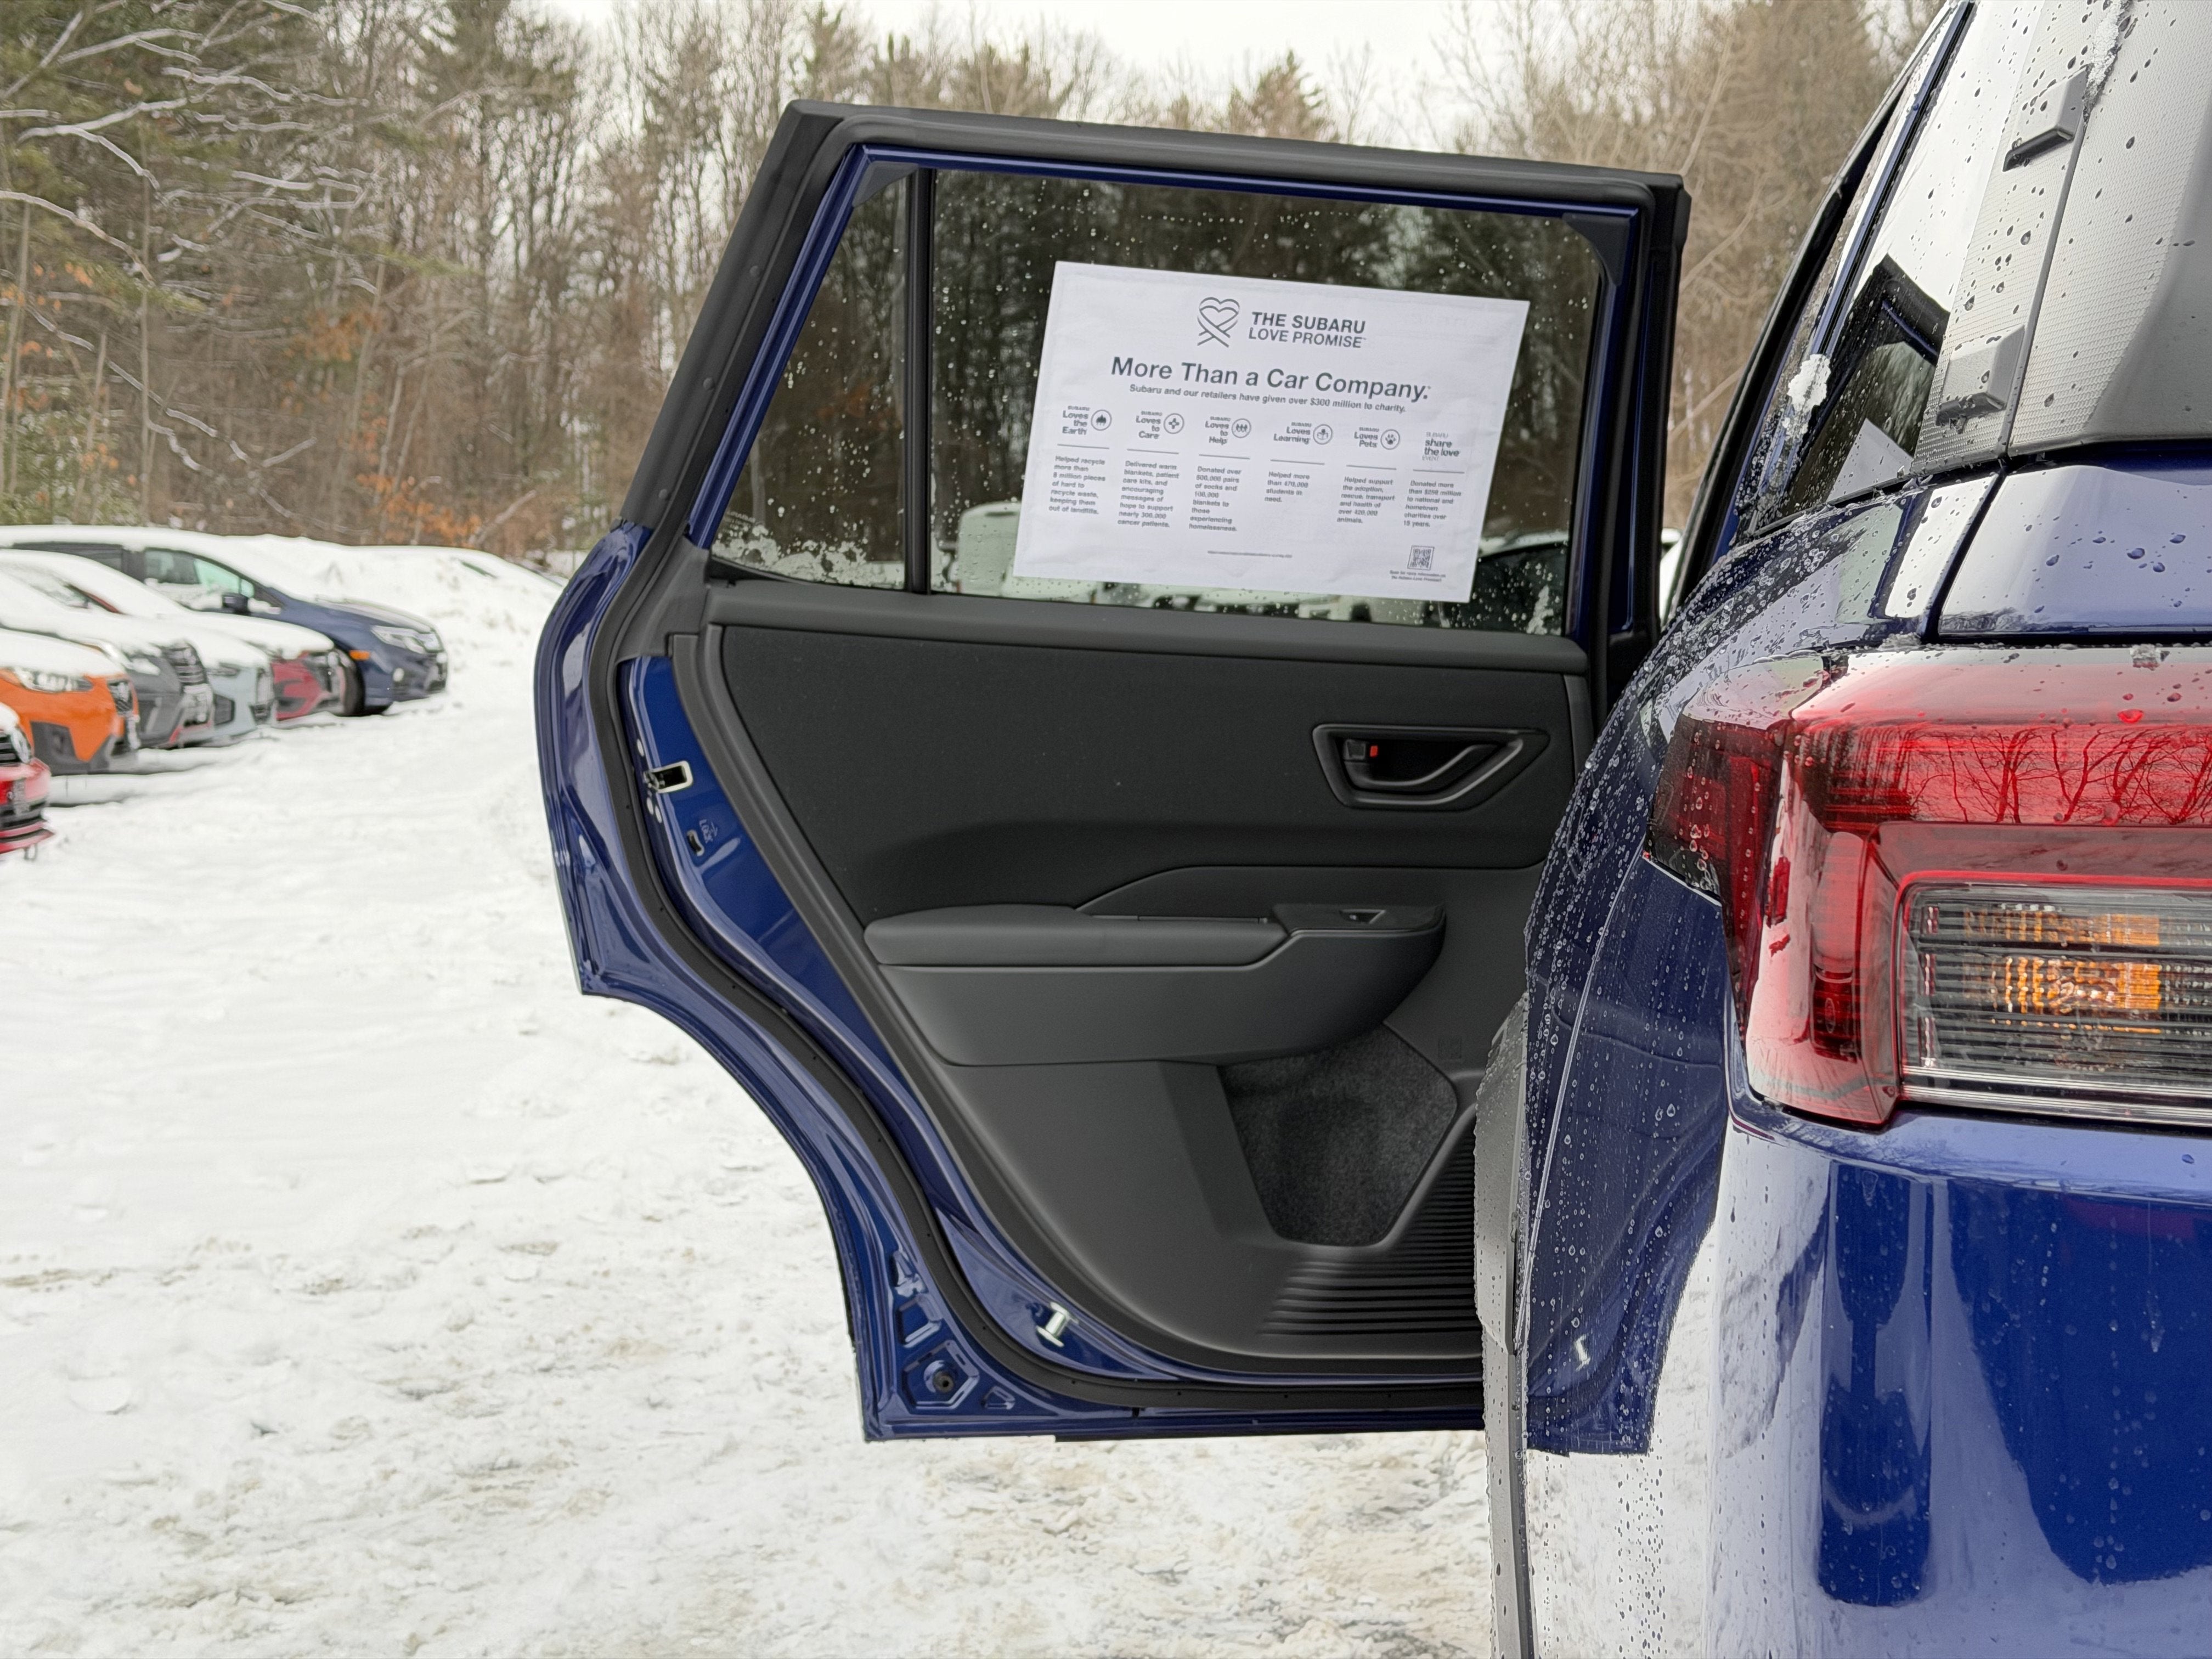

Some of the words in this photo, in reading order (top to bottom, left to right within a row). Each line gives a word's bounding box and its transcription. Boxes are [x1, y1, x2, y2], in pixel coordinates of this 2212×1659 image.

[1252, 312, 1286, 327] THE
[1291, 315, 1365, 334] SUBARU
[1248, 328, 1289, 342] LOVE
[1292, 331, 1362, 348] PROMISE
[1111, 357, 1172, 379] More
[1181, 362, 1238, 385] Than
[1245, 371, 1259, 386] a
[1267, 368, 1309, 389] Car
[1130, 384, 1162, 394] Subaru
[1201, 391, 1237, 400] retailers
[1239, 393, 1260, 402] have
[1262, 395, 1285, 404] given
[1310, 398, 1330, 407] $300
[1333, 400, 1362, 409] million
[1375, 404, 1406, 414] charity.
[1063, 410, 1088, 419] Loves
[1136, 416, 1161, 424] Loves
[1205, 421, 1229, 429] Loves
[1062, 426, 1087, 435] Earth
[1286, 427, 1311, 435] Loves
[1209, 437, 1227, 445] Help
[1273, 433, 1309, 444] Learning
[1425, 438, 1452, 448] share
[1424, 447, 1439, 456] the
[1441, 448, 1459, 456] love
[1125, 460, 1157, 469] Delivered
[1122, 487, 1164, 495] encouraging
[1190, 516, 1232, 524] experiencing
